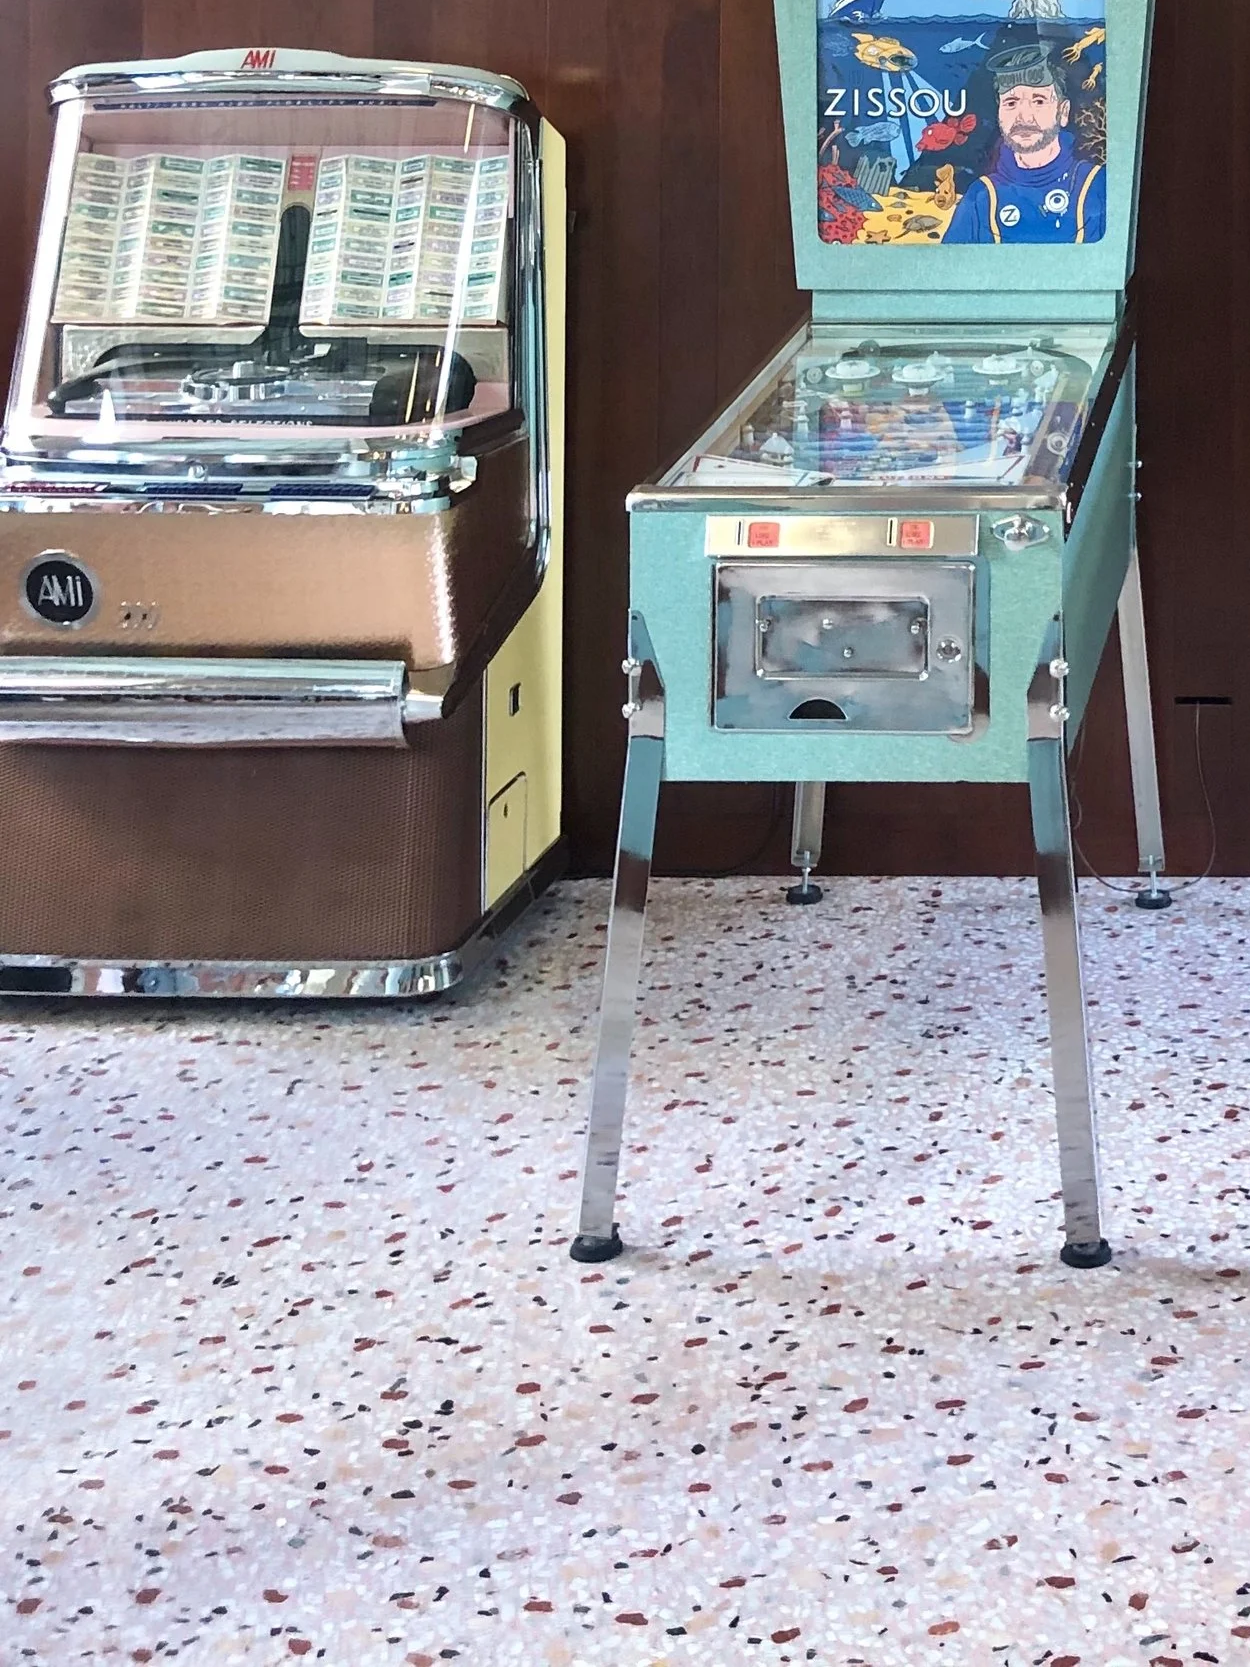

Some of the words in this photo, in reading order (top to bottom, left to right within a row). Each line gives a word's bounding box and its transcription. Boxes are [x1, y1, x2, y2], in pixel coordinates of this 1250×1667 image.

[241, 50, 276, 69] AMI
[823, 88, 967, 117] ZISSOU
[1003, 208, 1017, 223] Z
